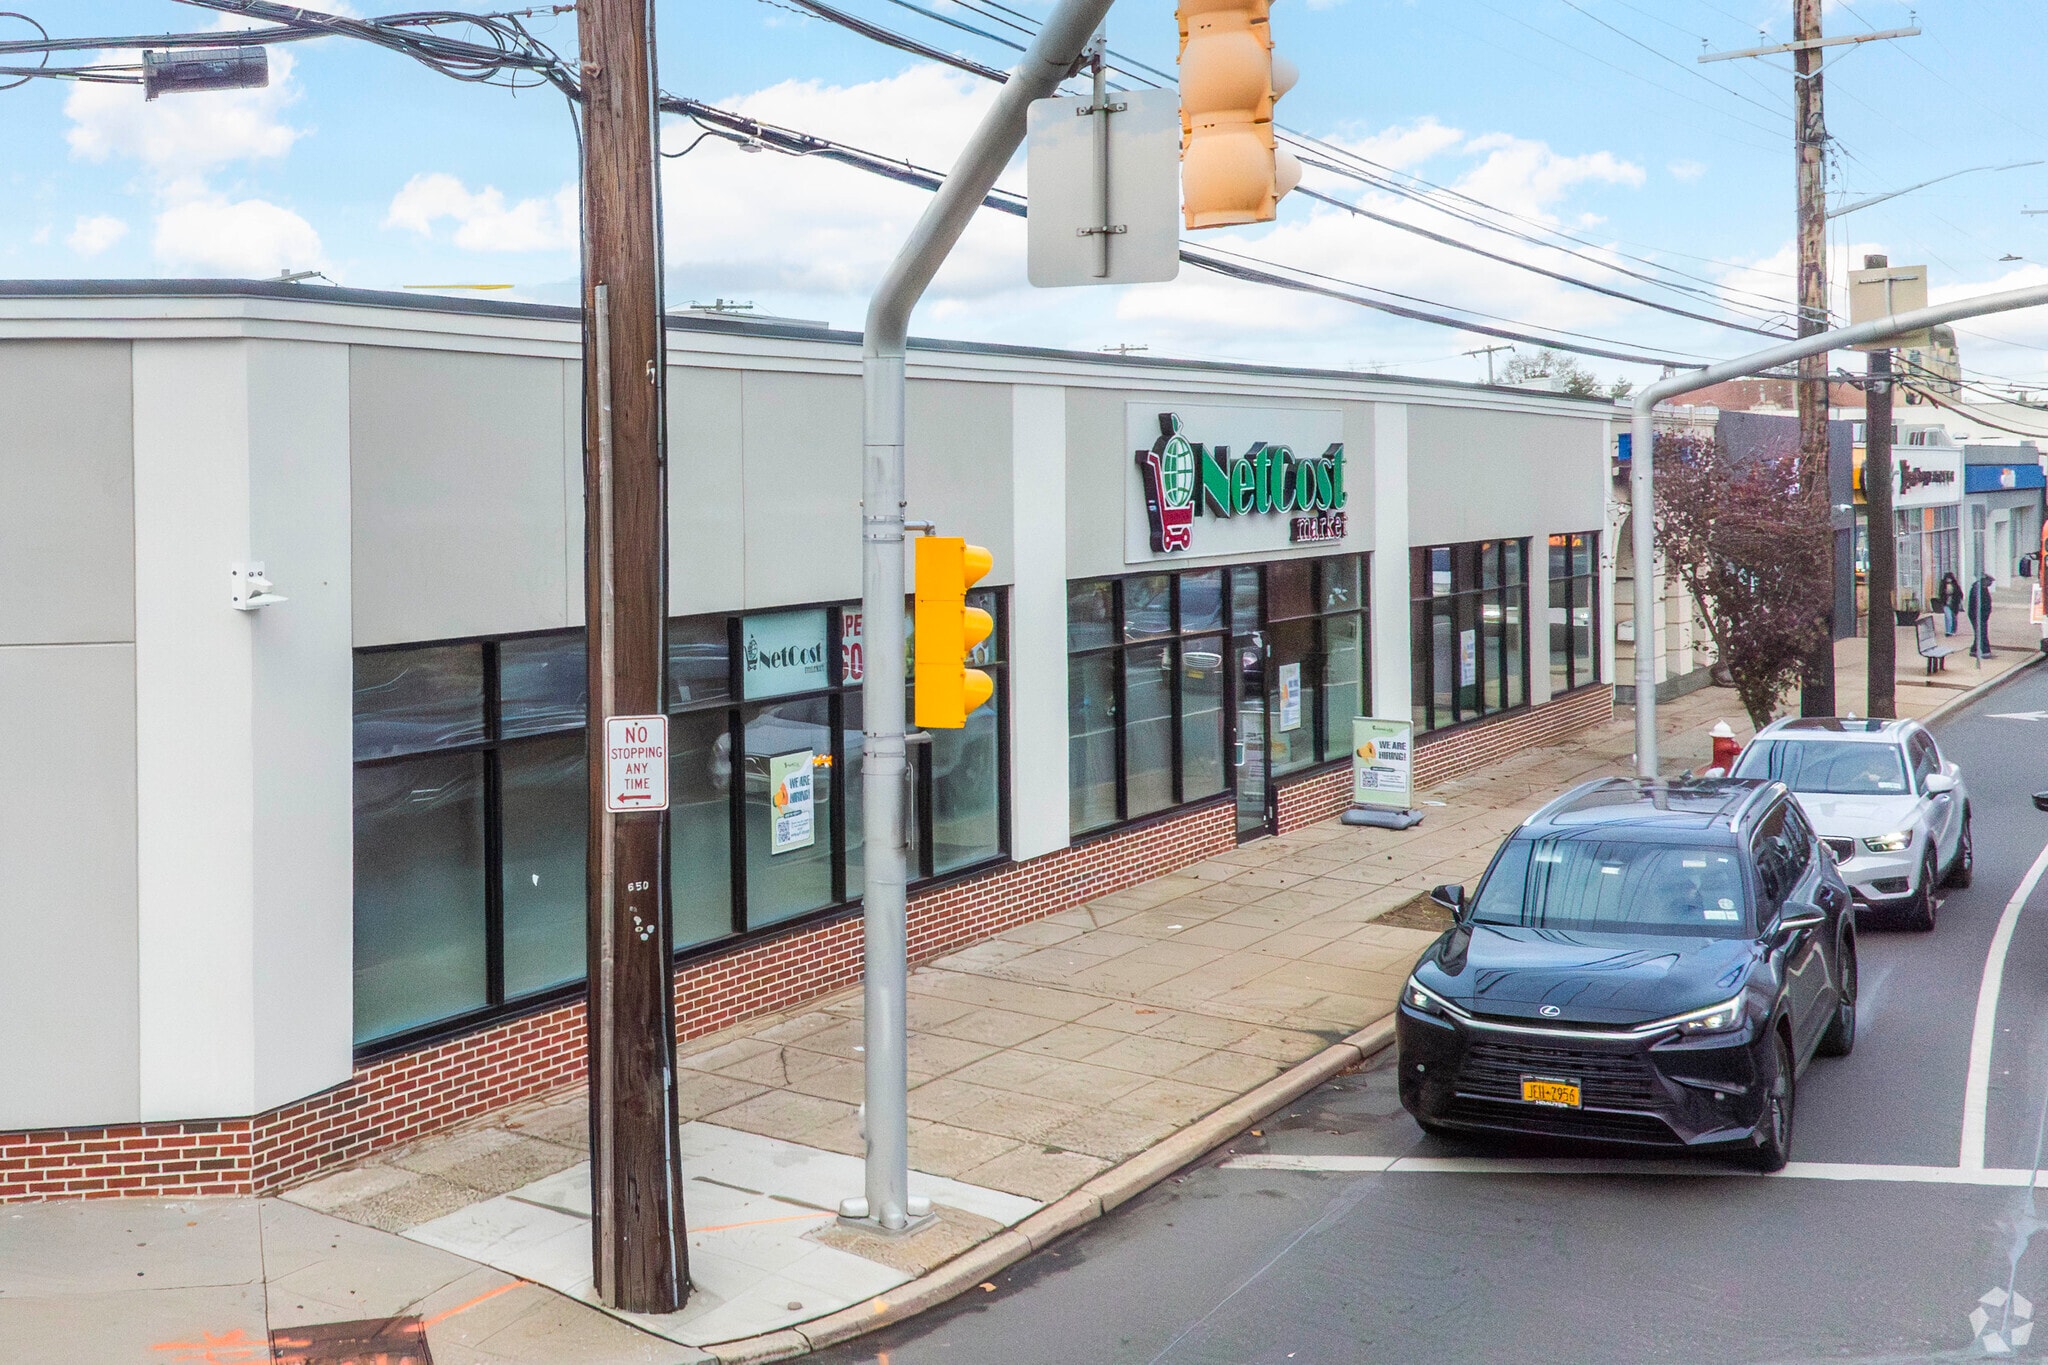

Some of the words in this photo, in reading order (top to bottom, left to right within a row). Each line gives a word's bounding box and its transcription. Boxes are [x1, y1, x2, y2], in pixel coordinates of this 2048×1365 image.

[1199, 442, 1347, 518] NetCost
[1291, 511, 1348, 543] market
[759, 641, 822, 669] NetCost
[625, 726, 648, 744] NO
[1379, 740, 1391, 750] WE
[1392, 741, 1407, 751] ARE
[611, 746, 663, 760] STOPPING
[625, 762, 649, 775] ANY
[624, 777, 651, 790] TIME
[789, 776, 799, 789] WE
[800, 774, 811, 788] ARE
[627, 880, 650, 892] 650
